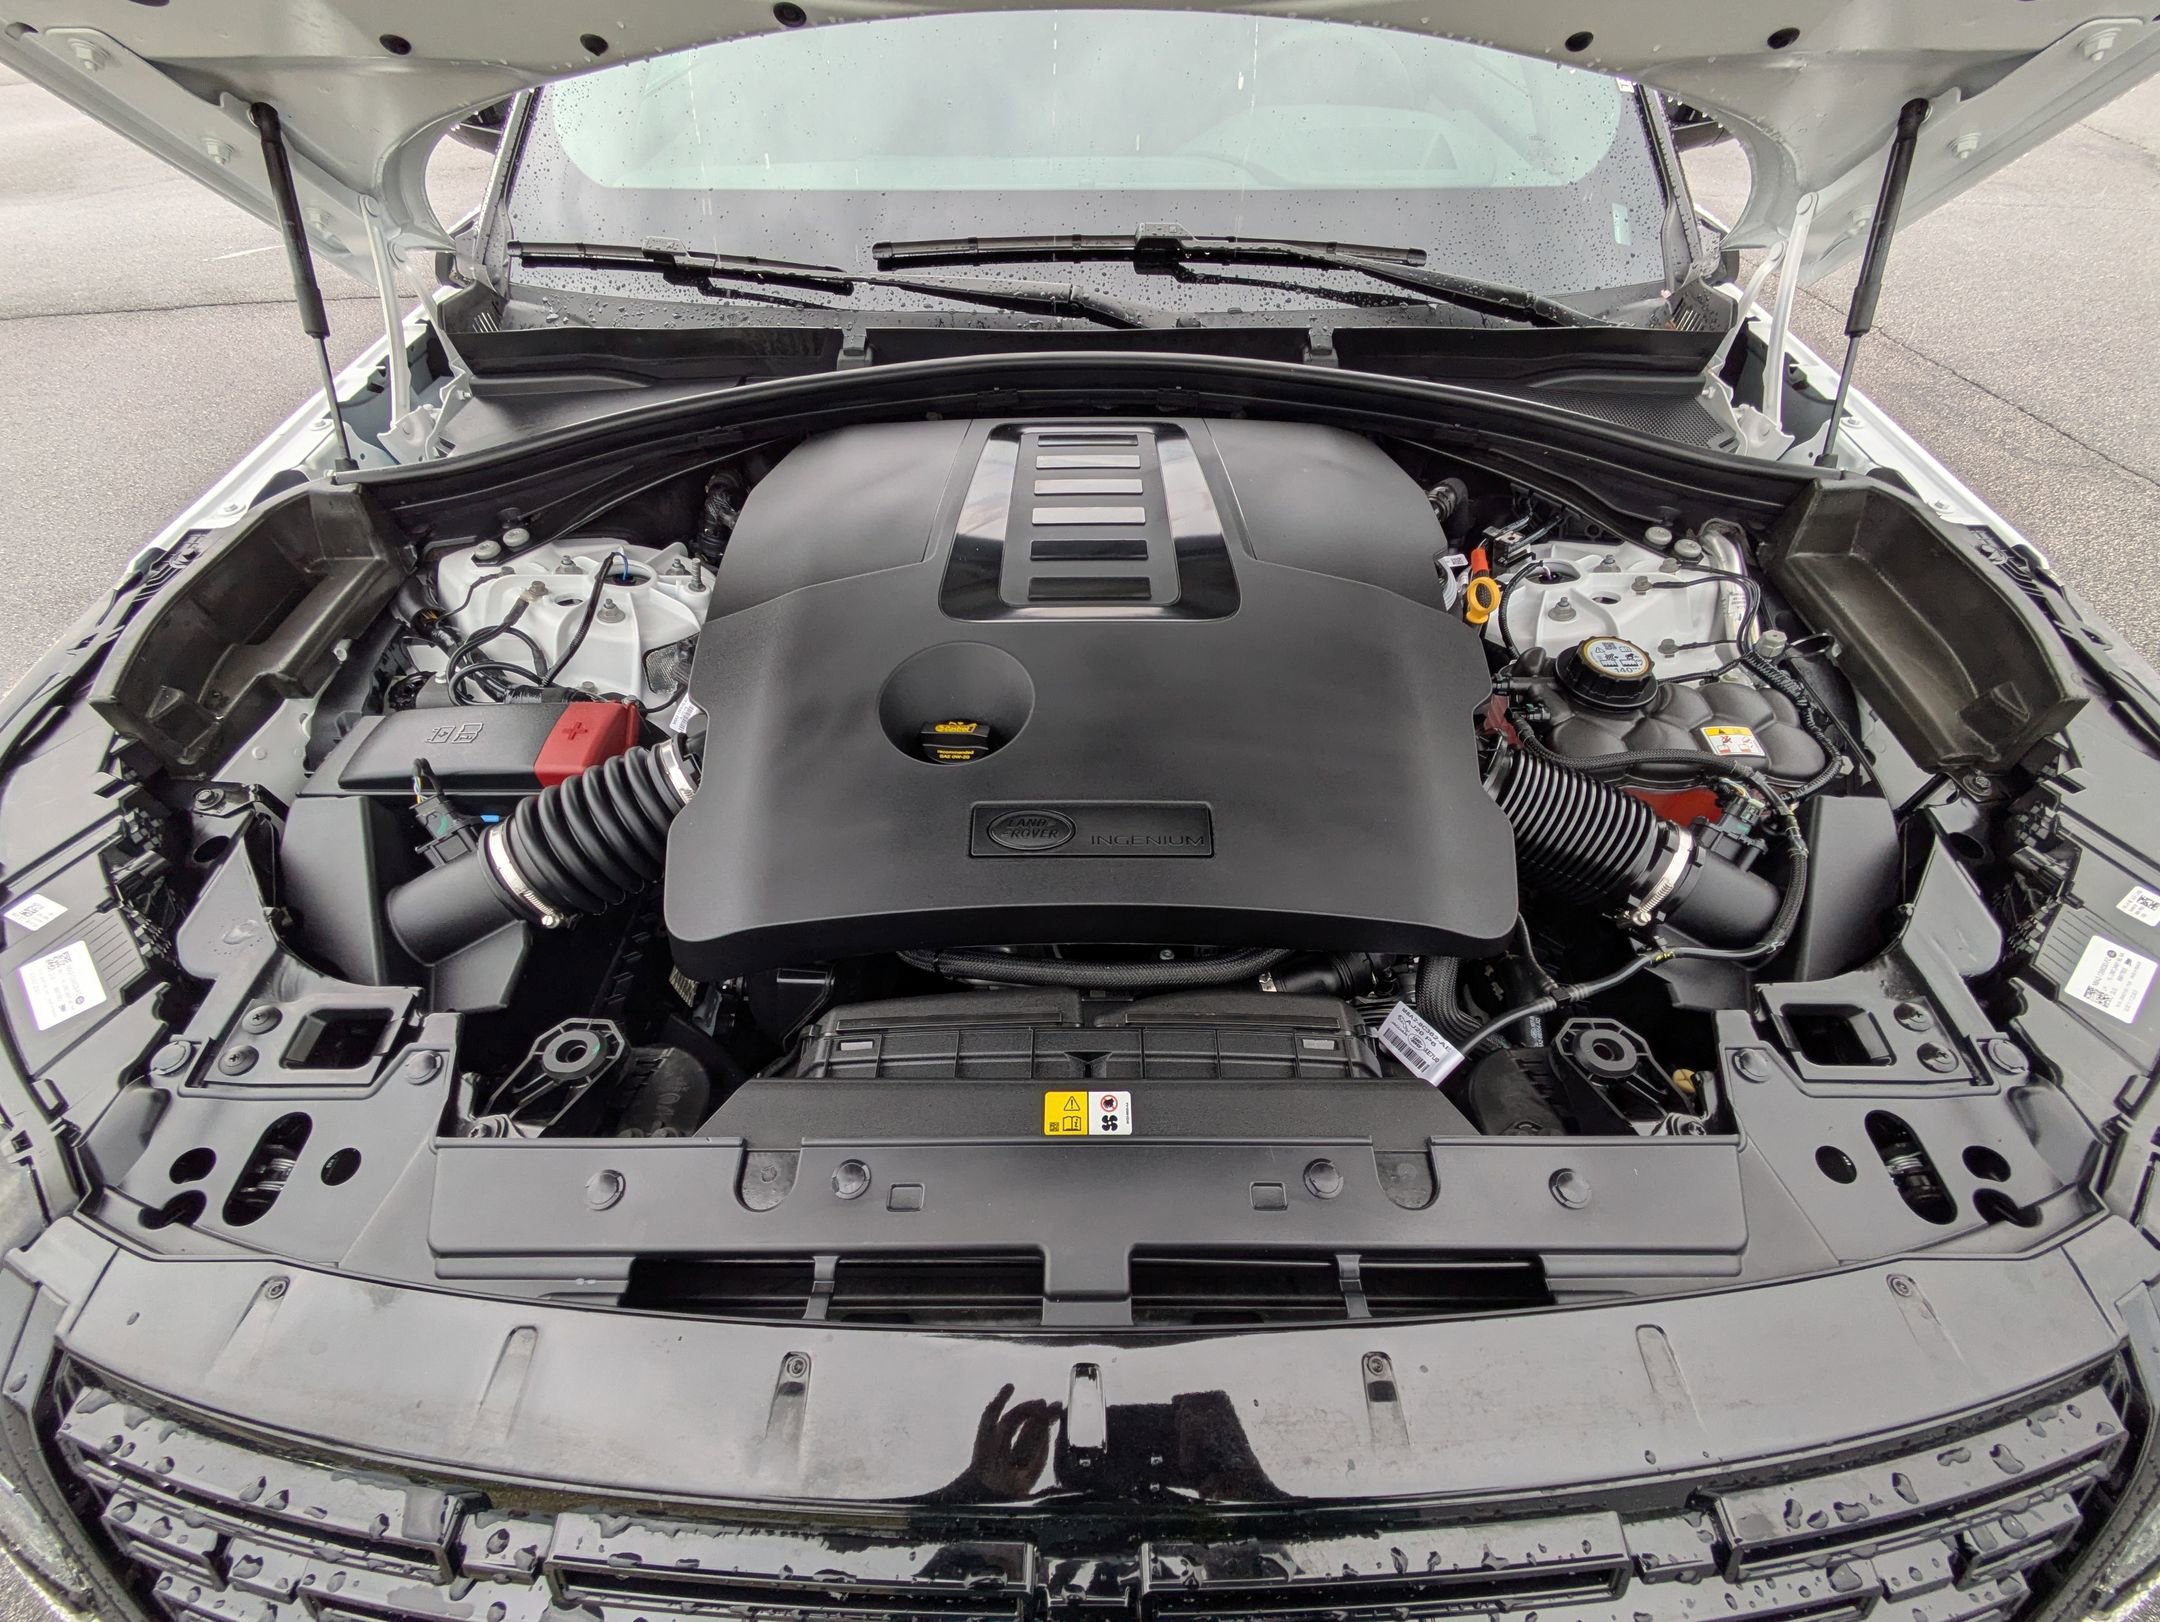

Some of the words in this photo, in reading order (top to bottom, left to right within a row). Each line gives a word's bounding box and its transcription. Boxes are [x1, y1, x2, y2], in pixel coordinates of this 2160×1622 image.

[1007, 817, 1048, 828] LAND
[1009, 828, 1060, 840] ROVER
[1090, 835, 1205, 847] INGENIUM
